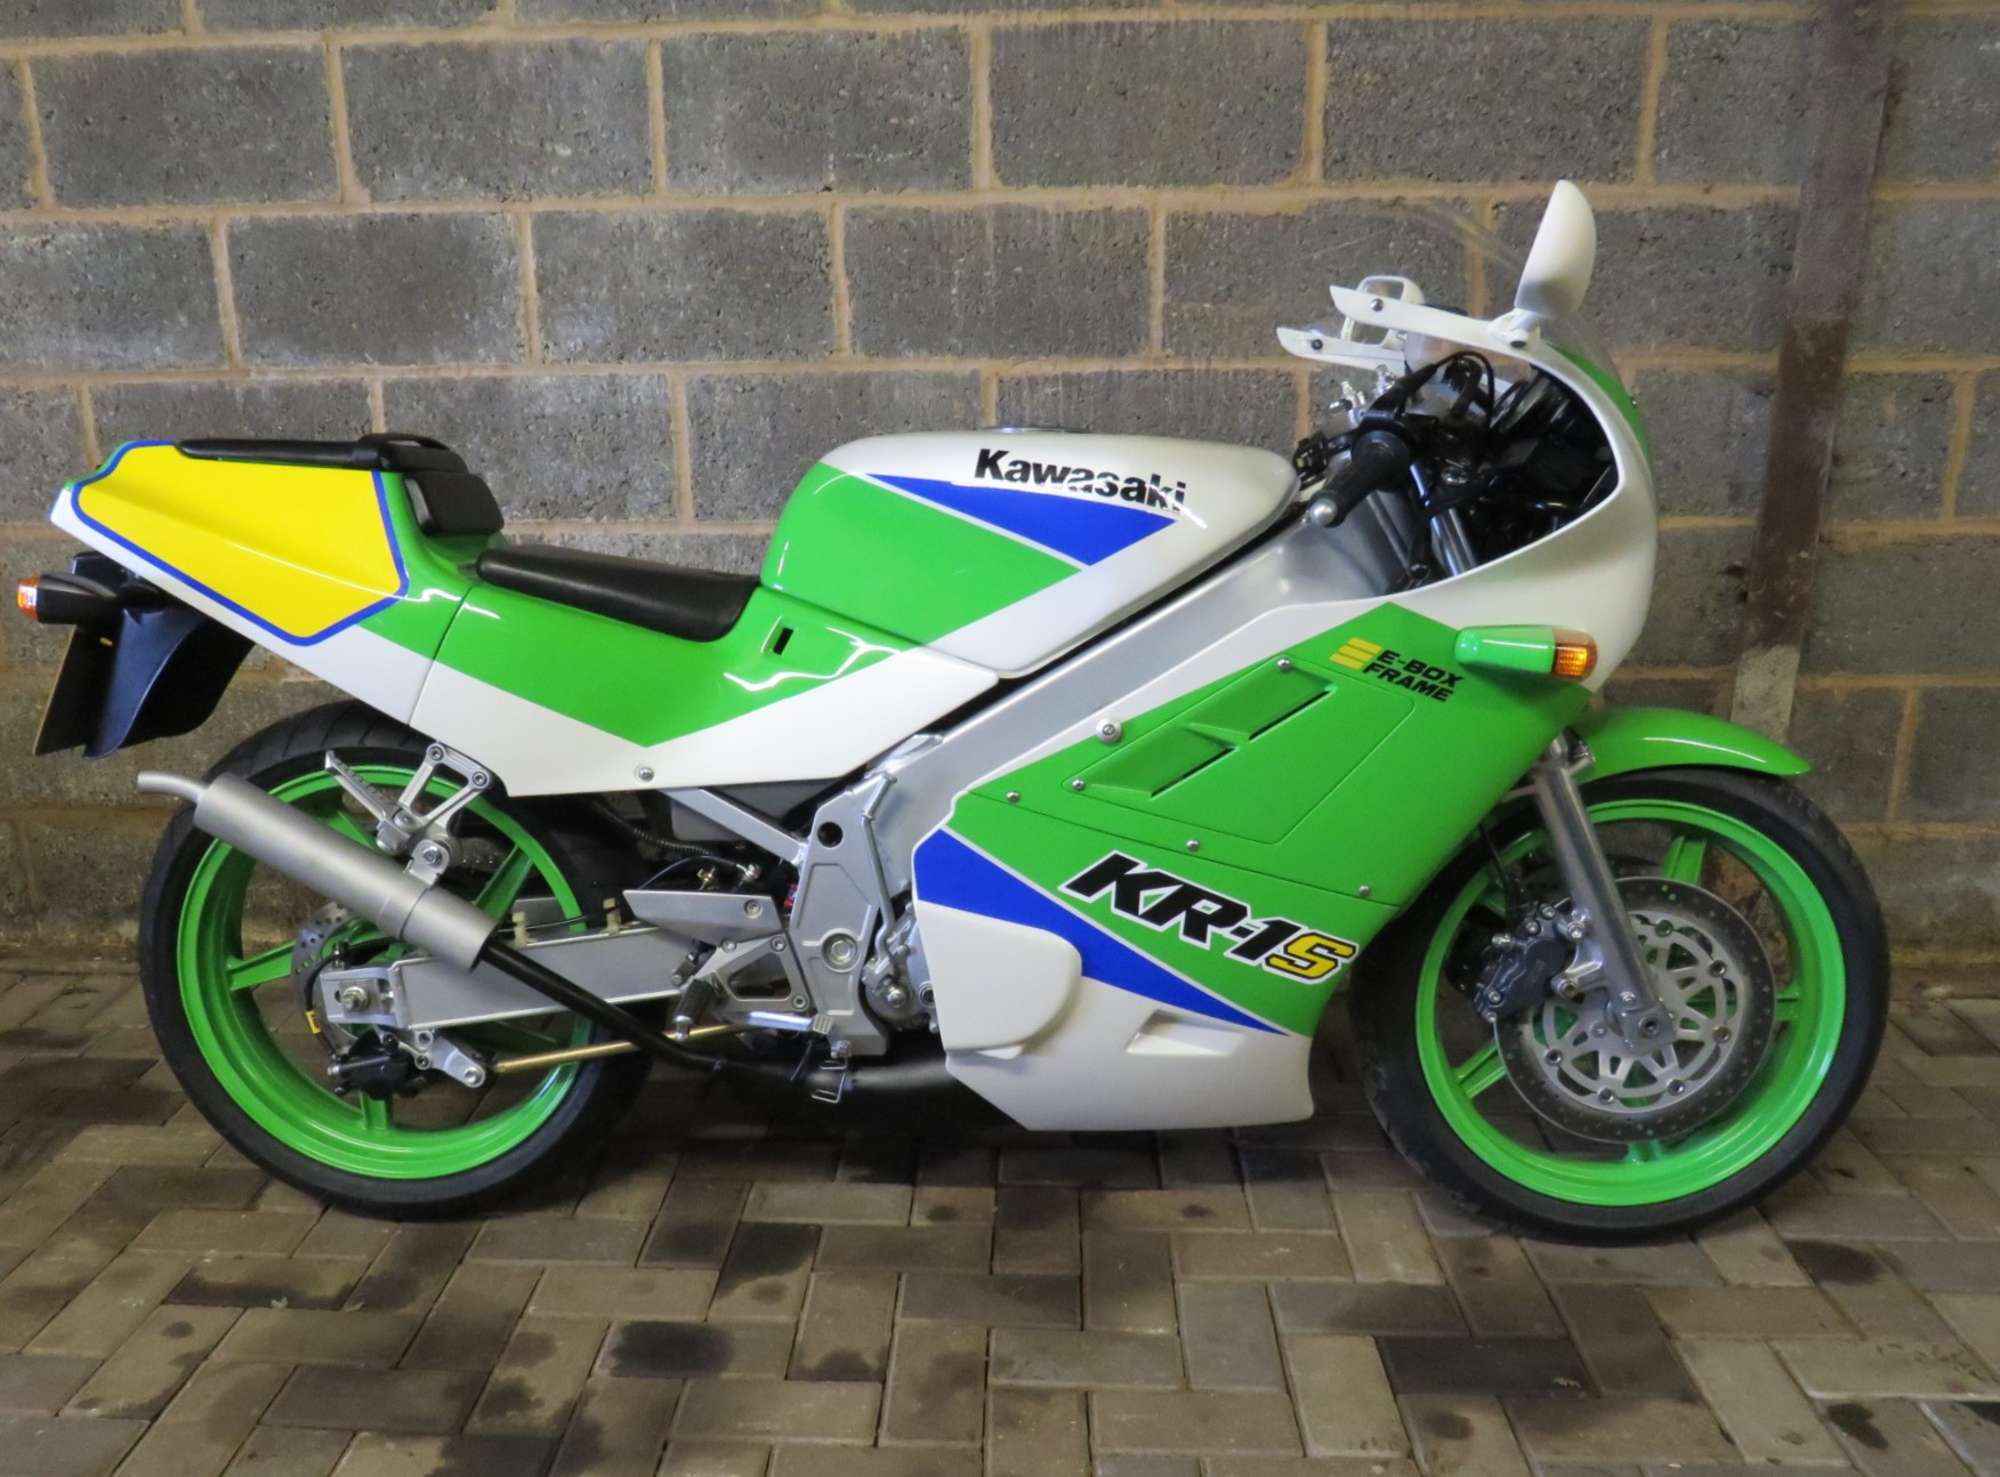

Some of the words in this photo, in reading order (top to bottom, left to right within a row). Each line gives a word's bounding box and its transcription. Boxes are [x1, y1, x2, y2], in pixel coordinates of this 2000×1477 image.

[974, 447, 1187, 512] Kawasaki
[1362, 662, 1454, 702] FRAME
[1376, 649, 1464, 688] E-BOX
[1060, 850, 1358, 983] KR-1S
